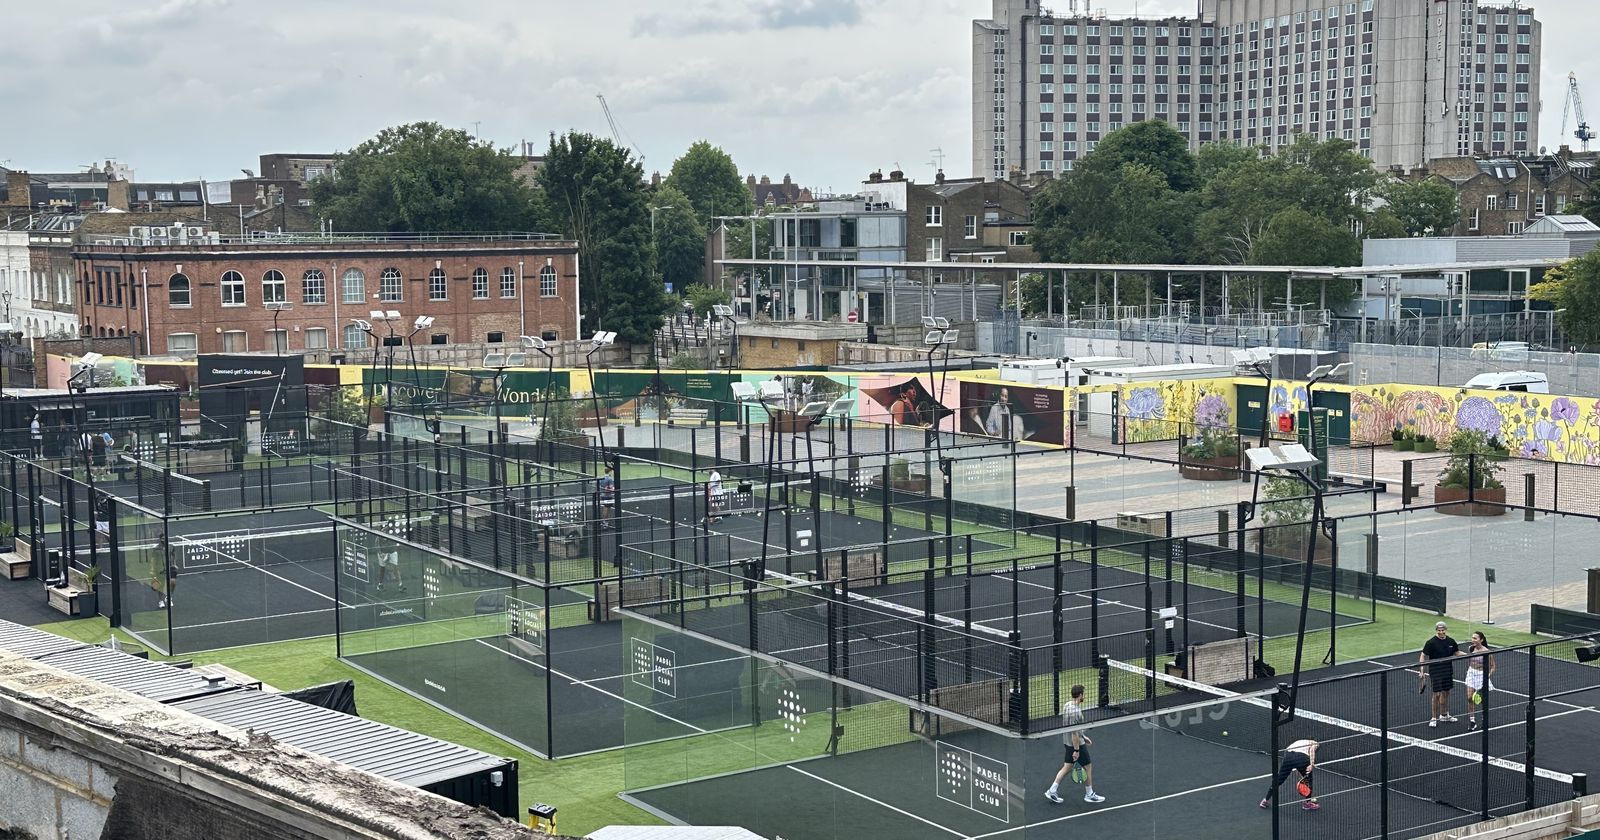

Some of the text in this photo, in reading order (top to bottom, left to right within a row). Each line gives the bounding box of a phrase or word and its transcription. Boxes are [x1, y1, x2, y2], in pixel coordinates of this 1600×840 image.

[496, 387, 557, 403] Wonde
[657, 675, 671, 686] CLUB
[976, 766, 1002, 782] PADEL
[974, 778, 1005, 796] SOCIAL
[979, 793, 1000, 807] CLUB
